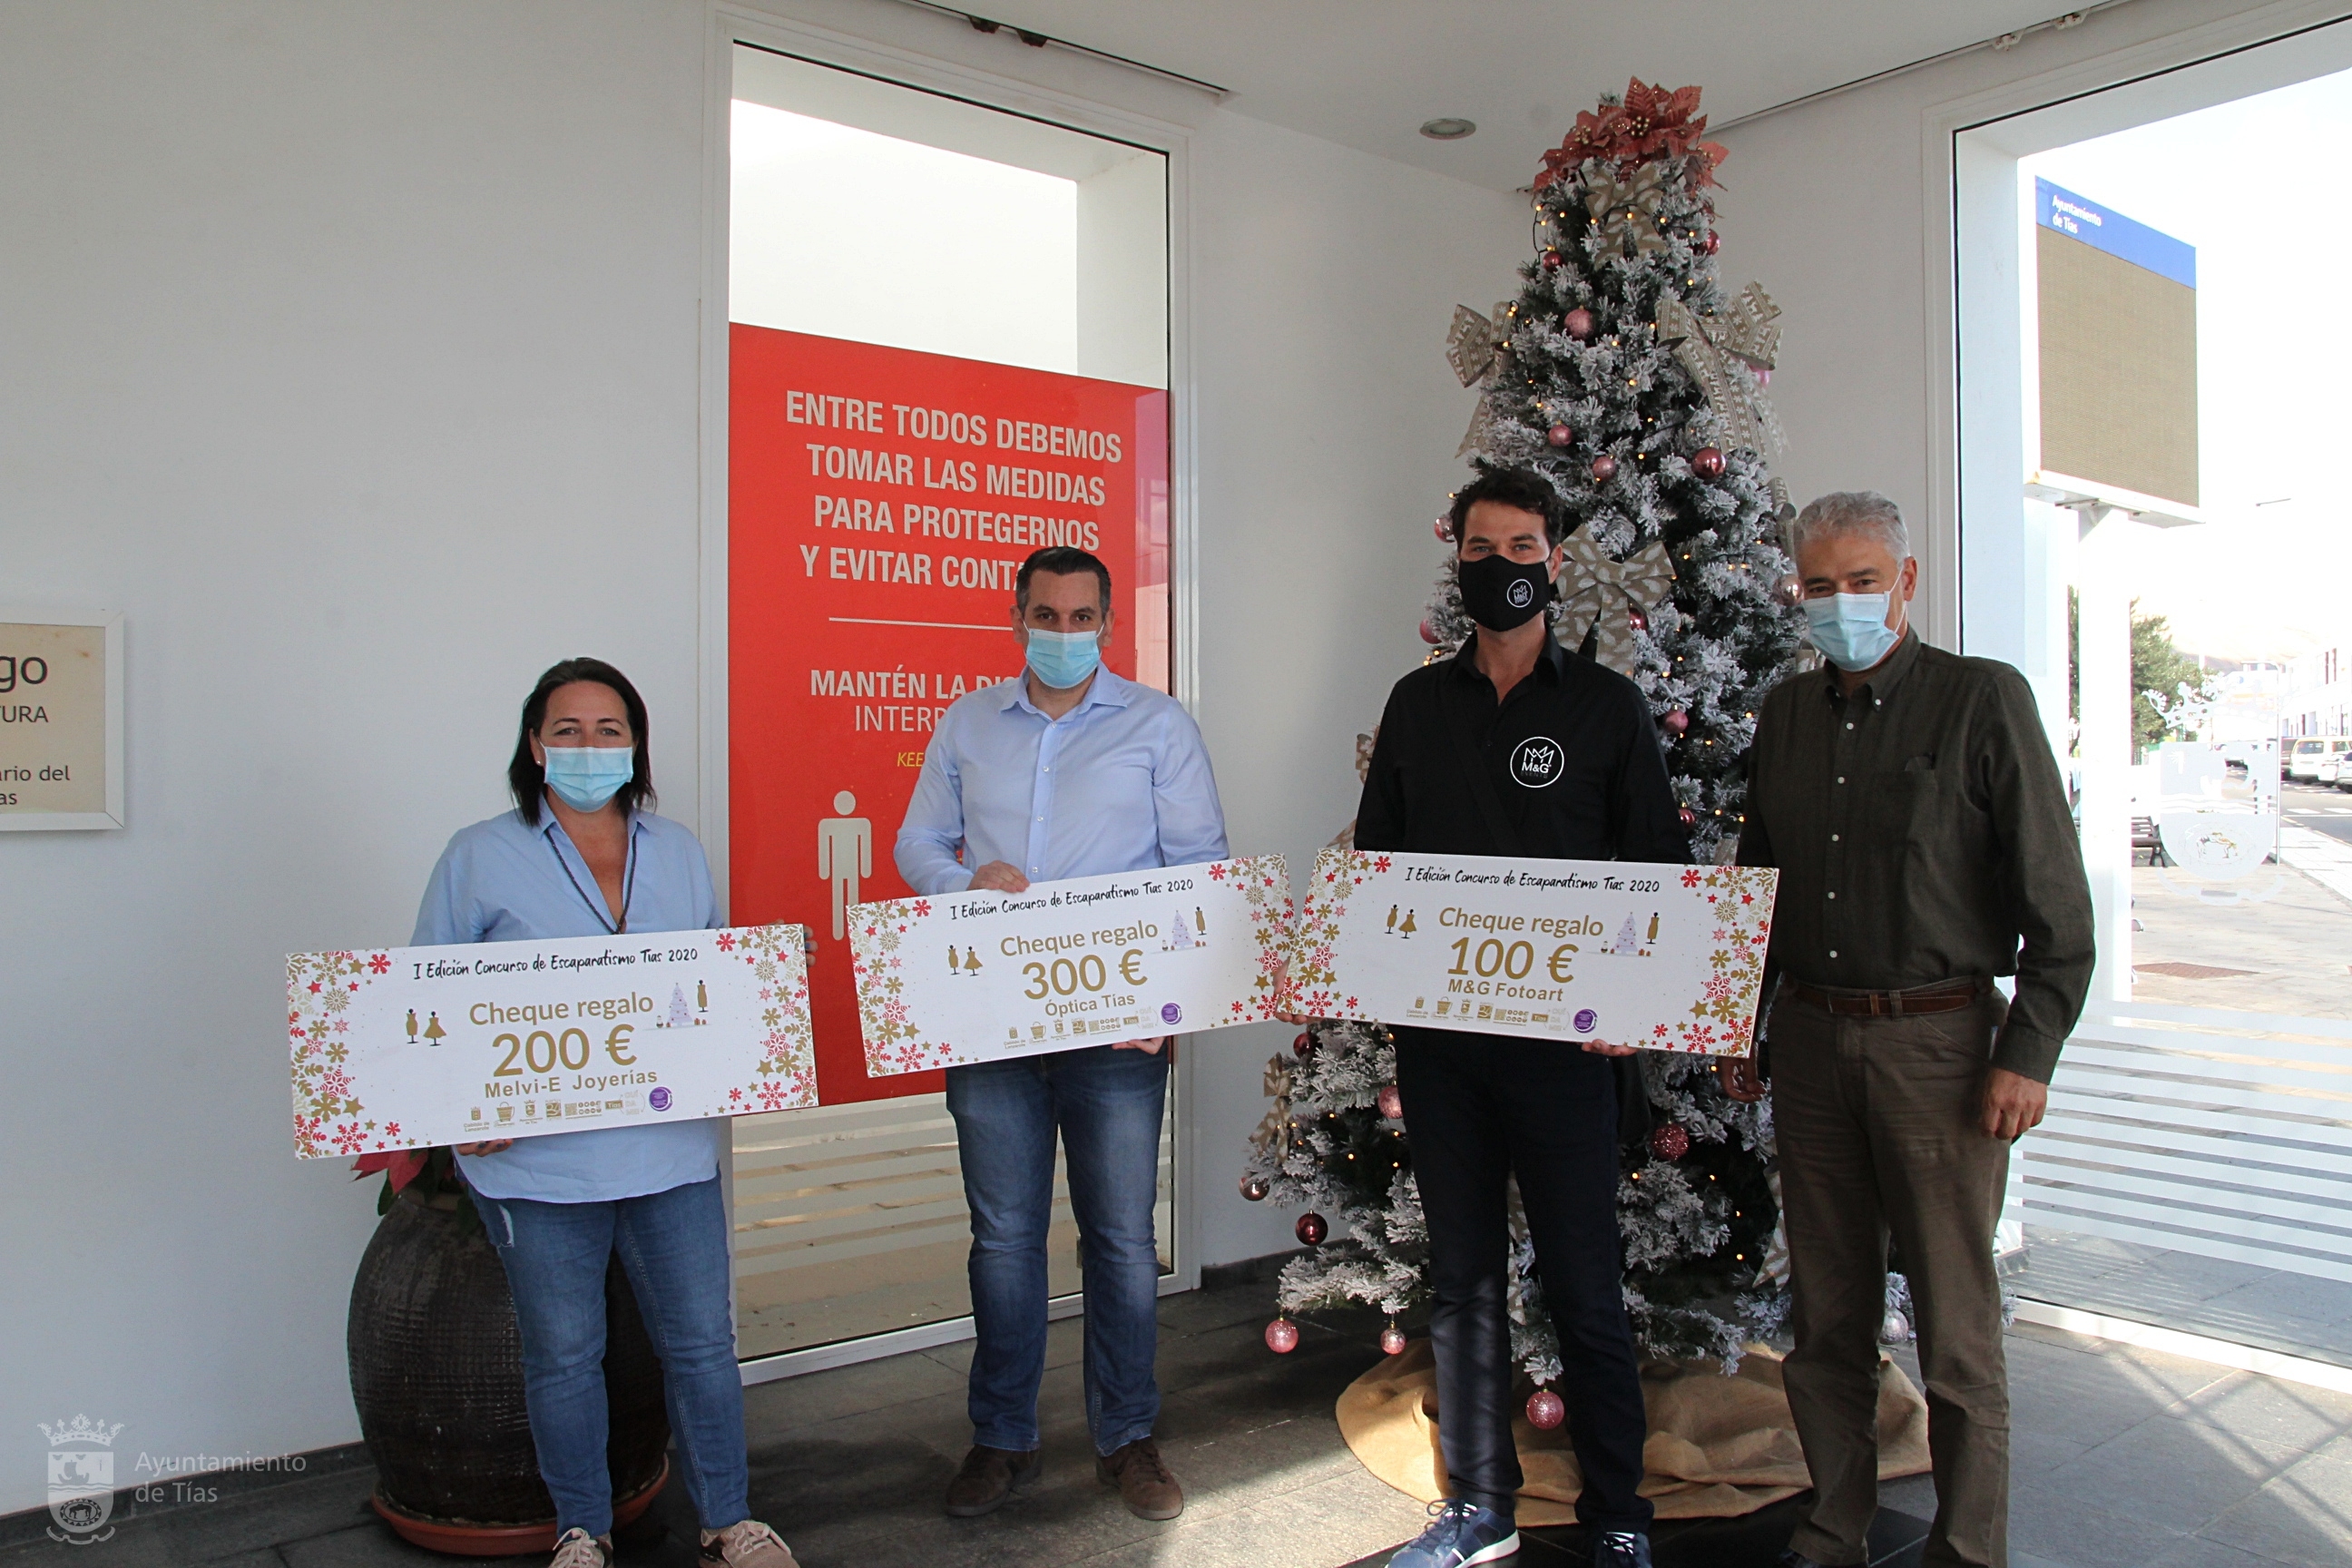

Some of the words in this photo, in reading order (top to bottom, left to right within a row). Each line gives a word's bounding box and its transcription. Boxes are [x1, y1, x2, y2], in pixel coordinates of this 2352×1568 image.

[2052, 212, 2063, 228] de
[787, 390, 883, 434] ENTRE
[892, 404, 987, 446] TODOS
[996, 417, 1122, 463] DEBEMOS
[806, 443, 914, 486] TOMAR
[924, 456, 977, 493] LAS
[986, 464, 1106, 506] MEDIDAS
[815, 495, 895, 534] PARA
[904, 503, 1100, 552] PROTEGERNOS
[799, 544, 820, 578] Y
[829, 547, 932, 585] EVITAR
[810, 664, 926, 699] MANTÉN
[936, 674, 967, 700] LA
[0, 705, 49, 723] URA
[39, 765, 71, 781] del
[1521, 761, 1550, 774] M&G
[1406, 867, 1414, 881] I
[1416, 866, 1450, 882] Edición
[1455, 869, 1499, 885] Concurso
[1504, 869, 1515, 885] de
[1519, 872, 1598, 890] Escaparatismo
[1630, 879, 1660, 893] 2020
[950, 906, 957, 920] I
[961, 901, 997, 918] Edición
[1002, 898, 1046, 914] Concurso
[1050, 892, 1063, 907] de
[1065, 884, 1139, 906] Escaparatismo
[1167, 878, 1193, 892] 2020
[1000, 933, 1085, 956] Cheque
[1092, 920, 1158, 946] regalo
[1439, 906, 1525, 933] Cheque
[1532, 915, 1603, 938] regalo
[413, 963, 421, 979] I
[426, 959, 469, 978] Edición
[475, 959, 528, 975] Concurso
[533, 953, 546, 971] de
[551, 949, 635, 972] Escaparatismo
[668, 948, 698, 962] 2020
[1022, 955, 1106, 1000] 300
[1118, 948, 1148, 986] €
[1447, 936, 1534, 980] 100
[1546, 943, 1579, 984] €
[1045, 999, 1097, 1018] Óptica
[1102, 993, 1135, 1008] Tías
[1448, 978, 1490, 995] M&G
[1495, 982, 1563, 1002] Fotoart
[469, 1001, 569, 1025] Cheque
[577, 992, 653, 1020] regalo
[492, 1028, 590, 1077] 200
[604, 1024, 637, 1066] €
[485, 1076, 561, 1098] Melvi-E
[573, 1069, 658, 1092] Joyerías
